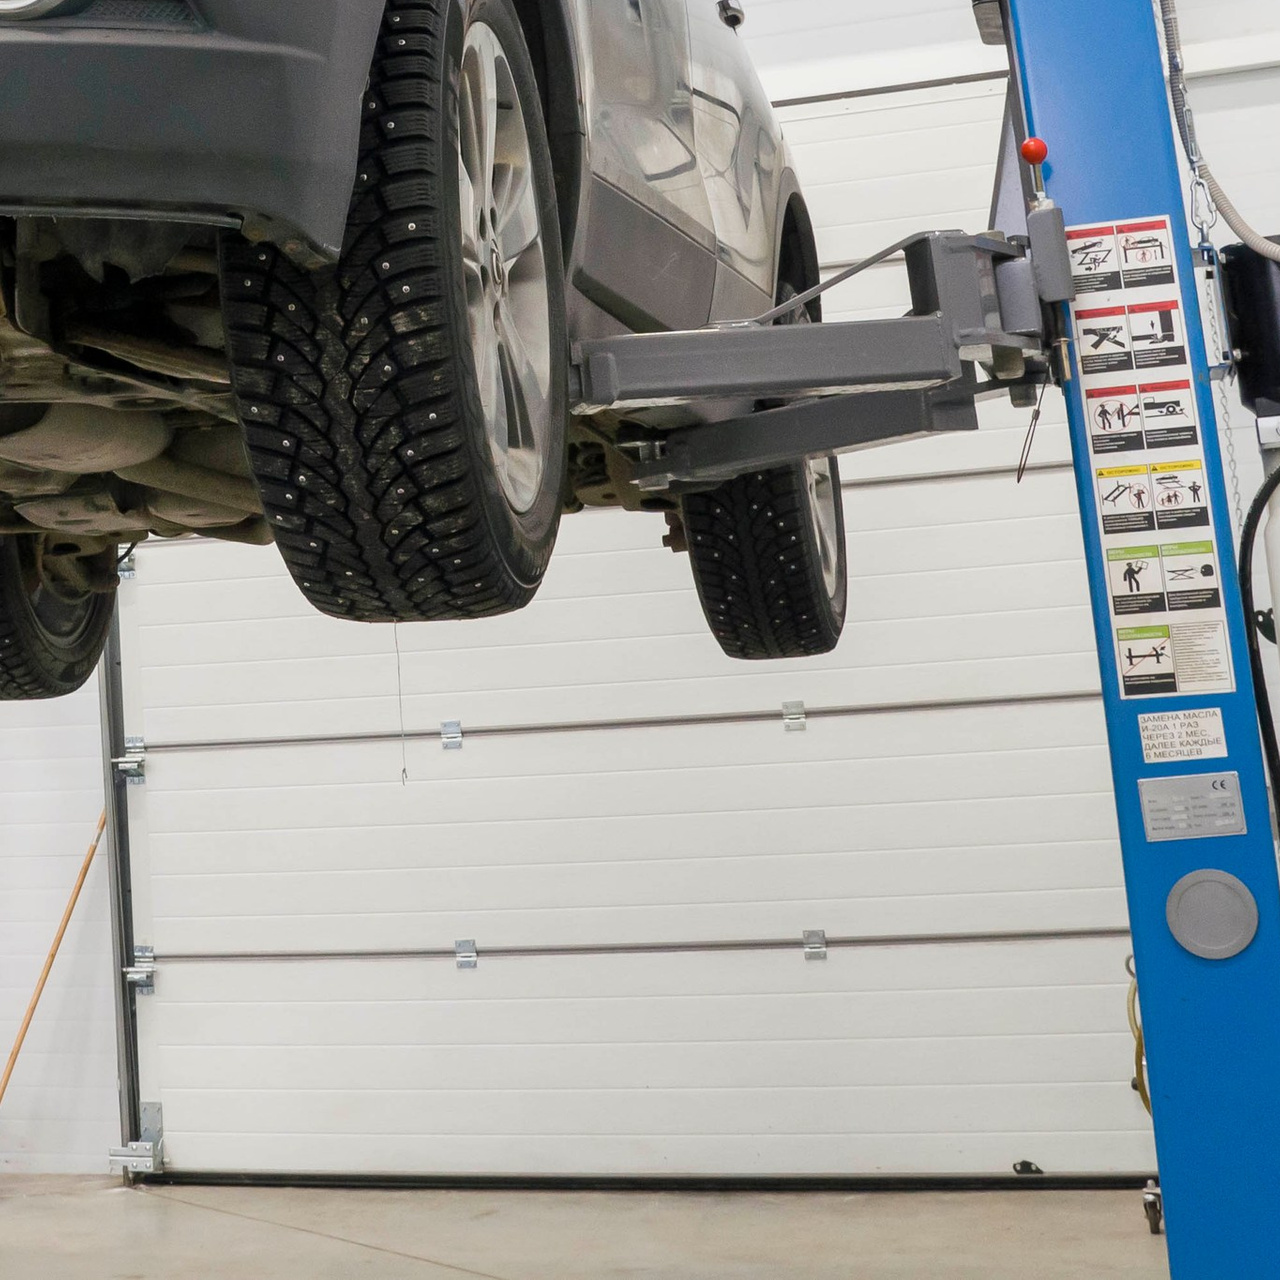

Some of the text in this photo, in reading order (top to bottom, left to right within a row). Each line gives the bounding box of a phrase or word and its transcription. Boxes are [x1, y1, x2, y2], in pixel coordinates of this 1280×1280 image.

[1140, 710, 1218, 724] ЗАМЕНА МАСЛА
[1180, 721, 1199, 729] РАЗ
[1143, 732, 1175, 741] ЧЕРЕЗ
[1178, 731, 1183, 739] 2
[1144, 737, 1222, 751] ДАЛЕЕ КАЖДЫЕ
[1154, 748, 1203, 759] МЕСЯЦЕВ
